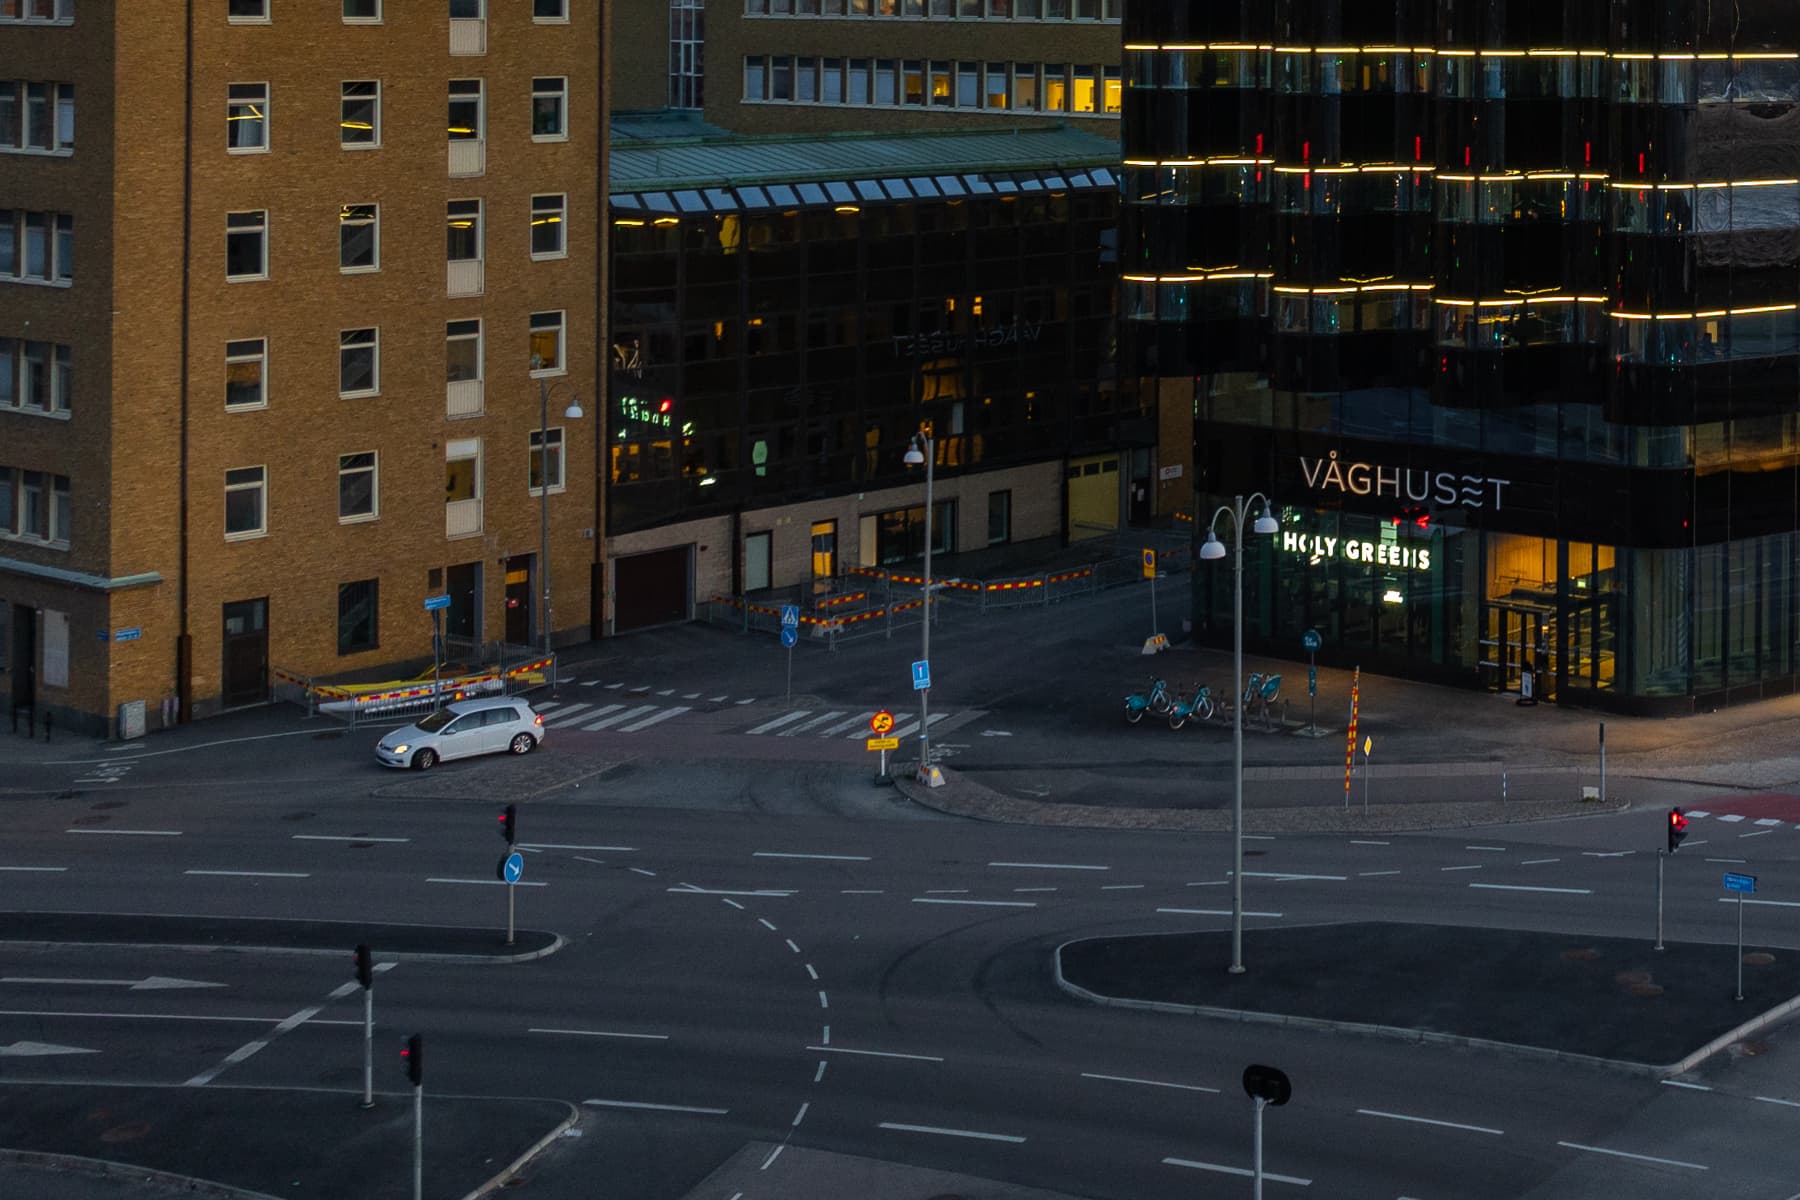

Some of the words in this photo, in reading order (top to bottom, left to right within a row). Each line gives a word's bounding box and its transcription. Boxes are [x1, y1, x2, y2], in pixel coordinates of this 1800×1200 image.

[1300, 450, 1511, 511] VÅGHUSET
[1283, 531, 1337, 558] HOLY
[1345, 539, 1431, 570] GREENS
